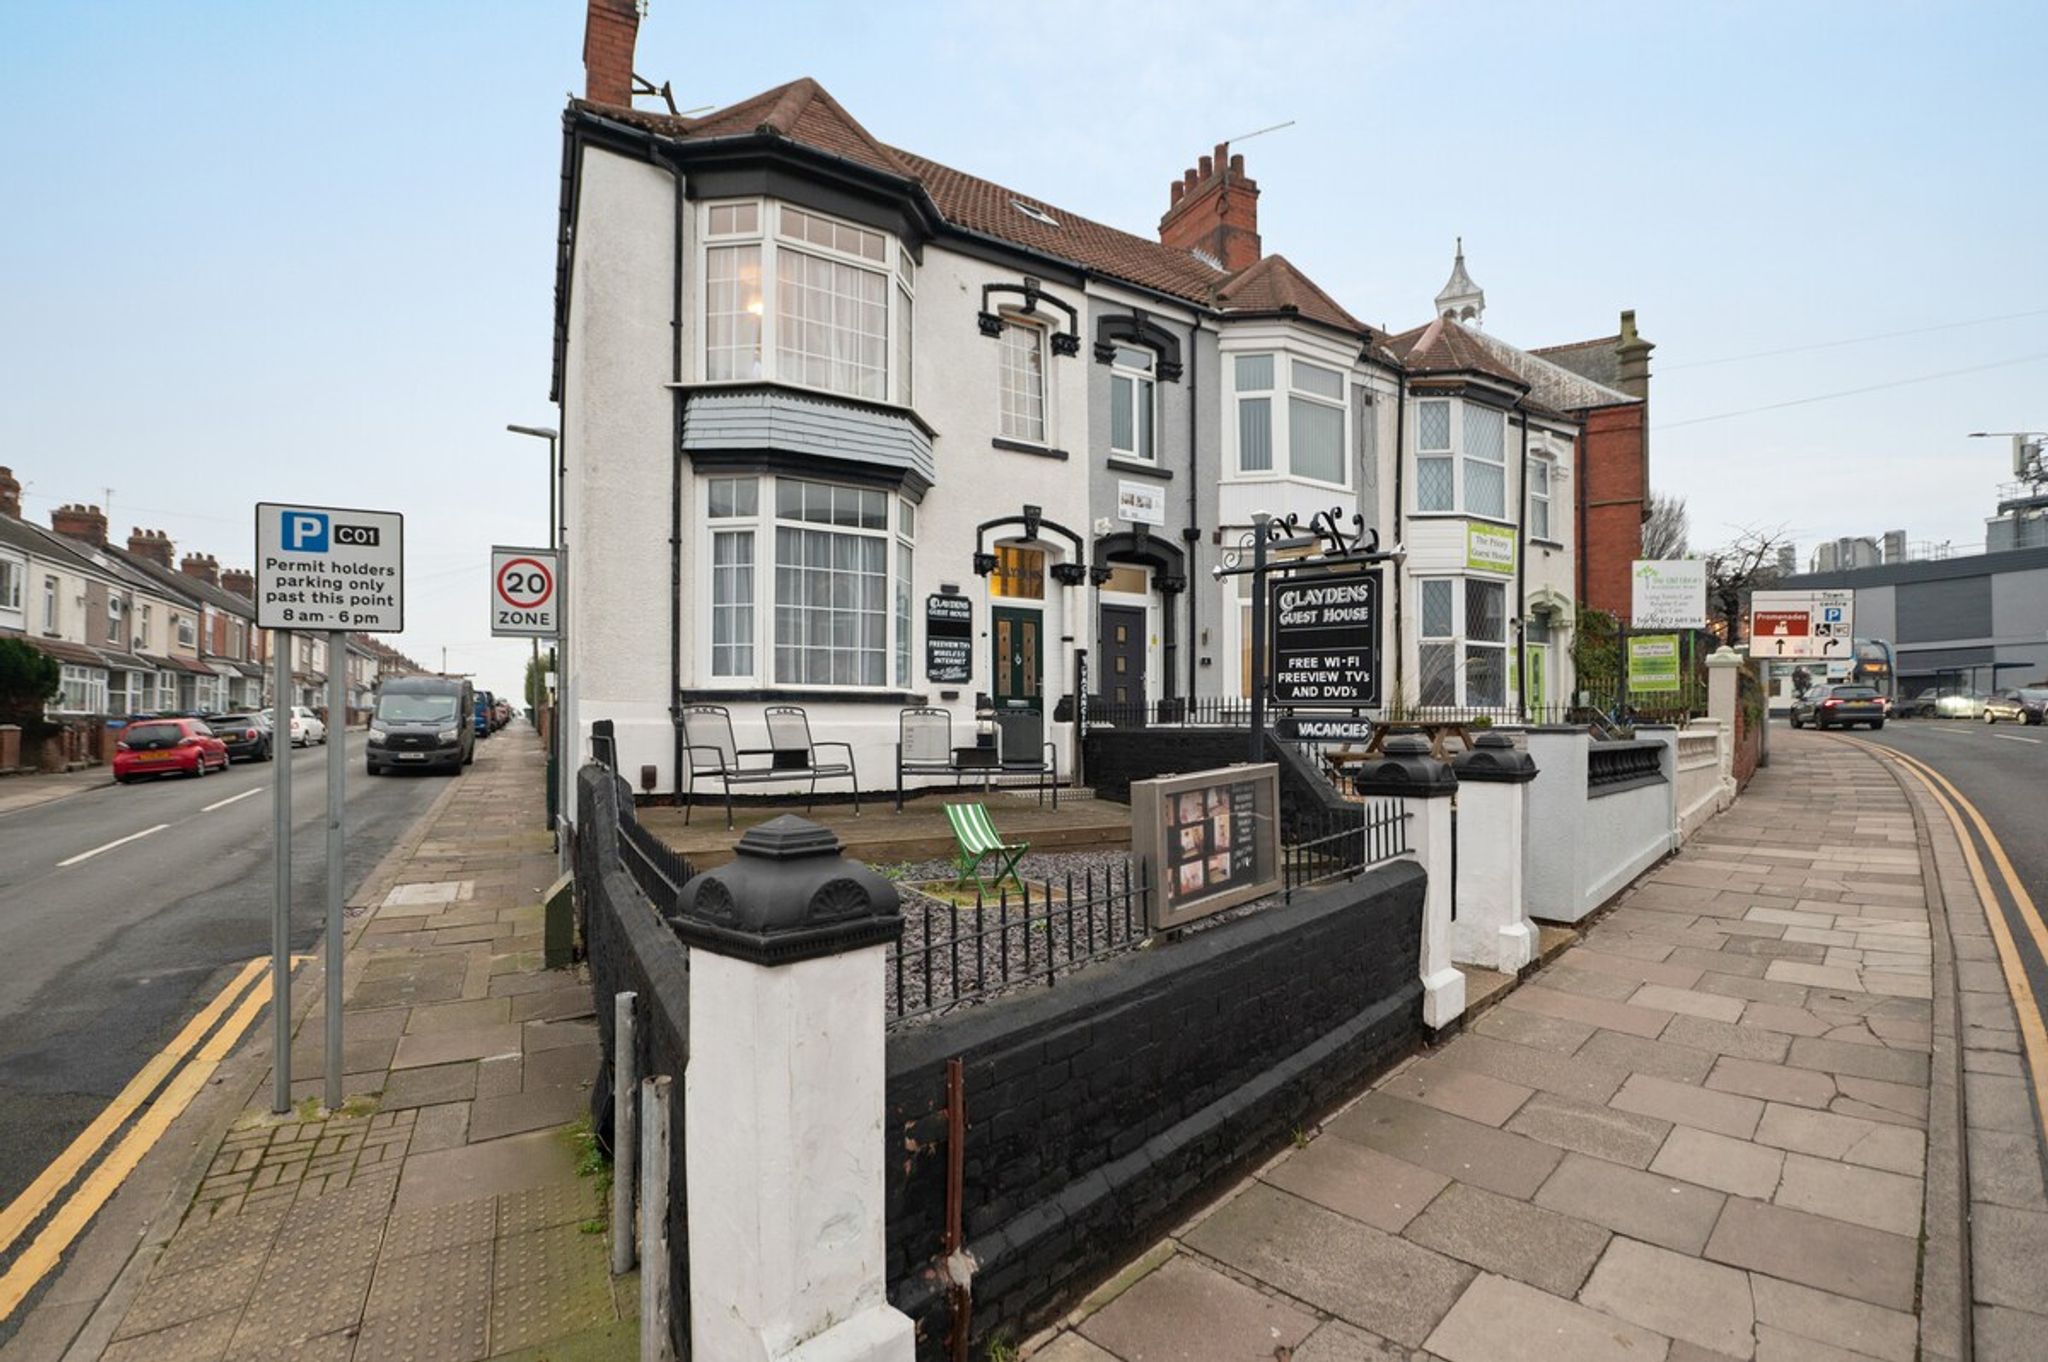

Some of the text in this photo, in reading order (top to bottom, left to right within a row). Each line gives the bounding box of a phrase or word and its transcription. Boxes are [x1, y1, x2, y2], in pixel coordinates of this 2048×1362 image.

[293, 516, 322, 548] P
[266, 558, 395, 576] Permit holders
[276, 576, 384, 593] parking only
[507, 572, 545, 594] 20
[266, 592, 394, 607] past this point
[1279, 584, 1369, 612] CLAYDENS
[283, 608, 294, 621] 8
[298, 611, 324, 622] am
[339, 611, 350, 622] 6
[353, 614, 379, 625] pm
[499, 611, 550, 625] ZONE
[1279, 607, 1369, 626] GUEST HOUSE
[1288, 657, 1319, 669] FREE
[1278, 671, 1340, 683] FREEVIEW
[1291, 686, 1319, 698] AND
[1298, 722, 1369, 738] VACANCIES
